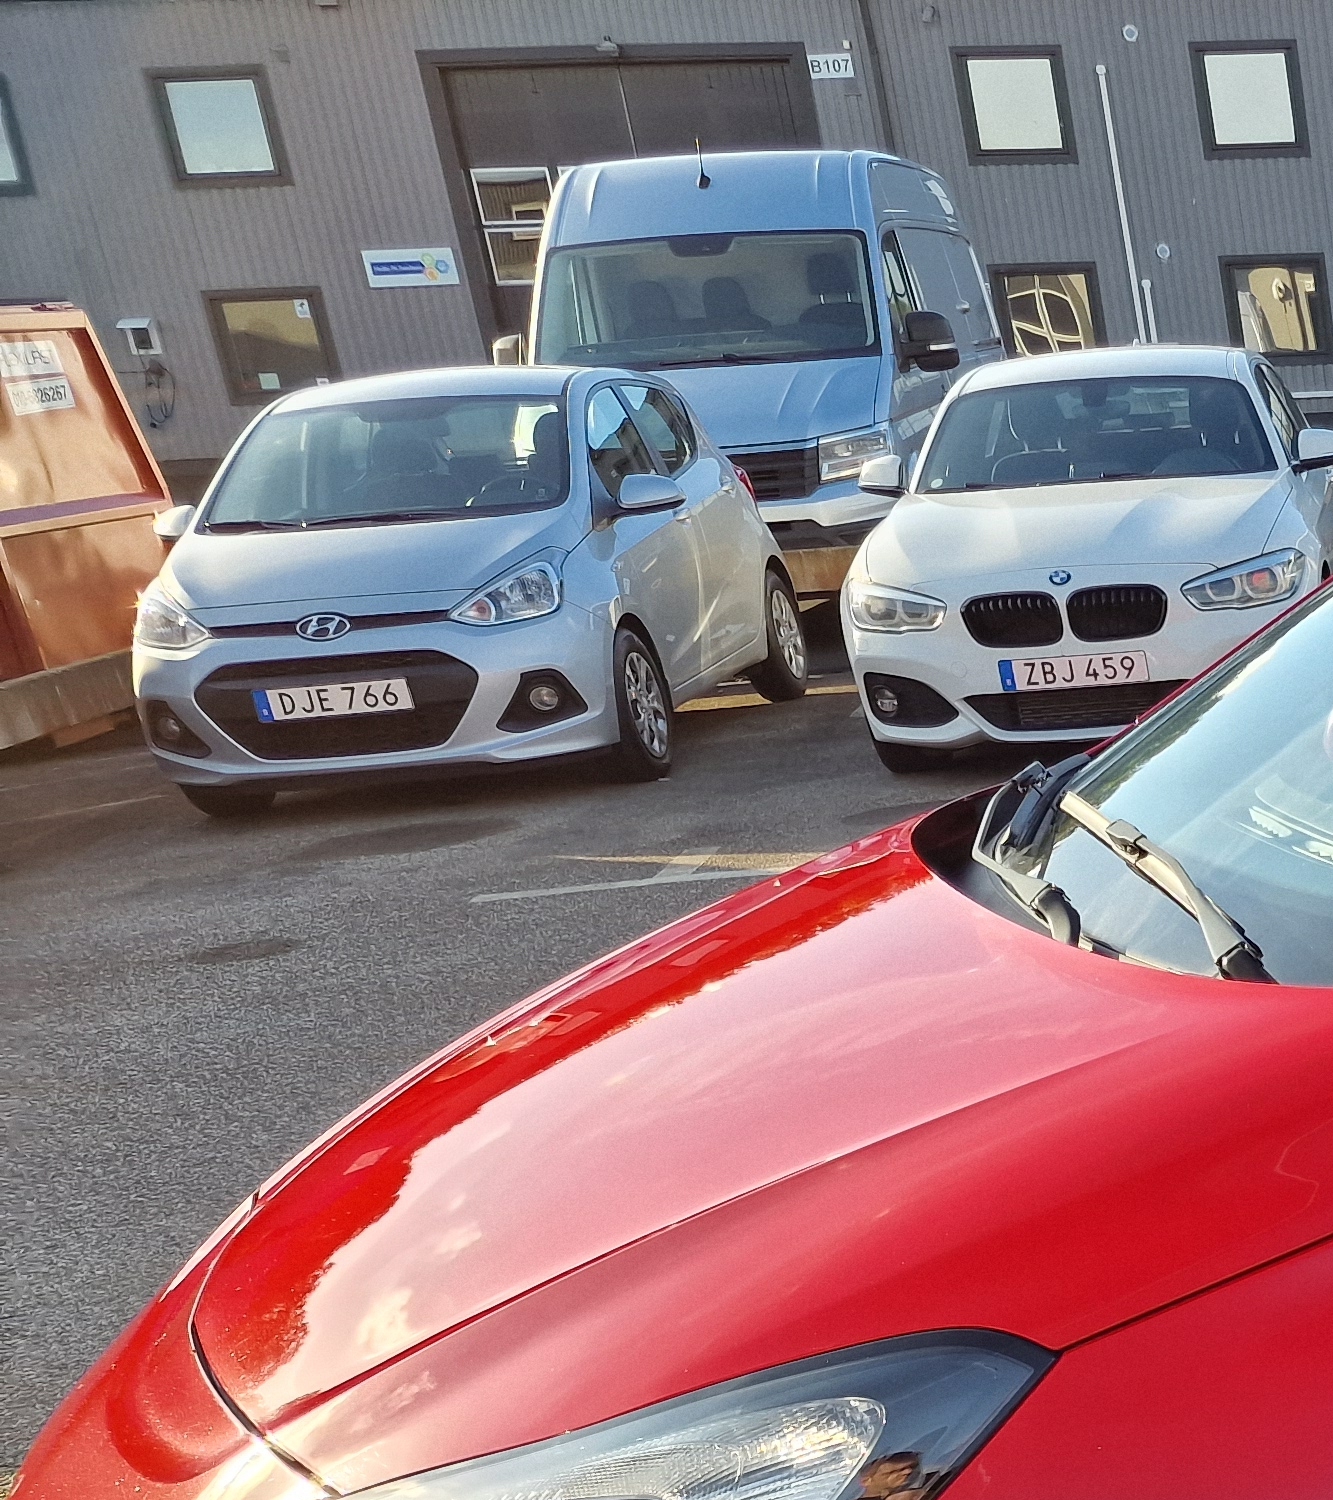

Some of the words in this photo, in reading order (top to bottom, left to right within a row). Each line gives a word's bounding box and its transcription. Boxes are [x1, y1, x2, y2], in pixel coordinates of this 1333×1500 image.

[810, 59, 849, 73] B107
[1023, 659, 1075, 686] ZBJ
[1085, 655, 1135, 681] 459
[278, 689, 335, 716] DJE
[341, 683, 399, 711] 766
